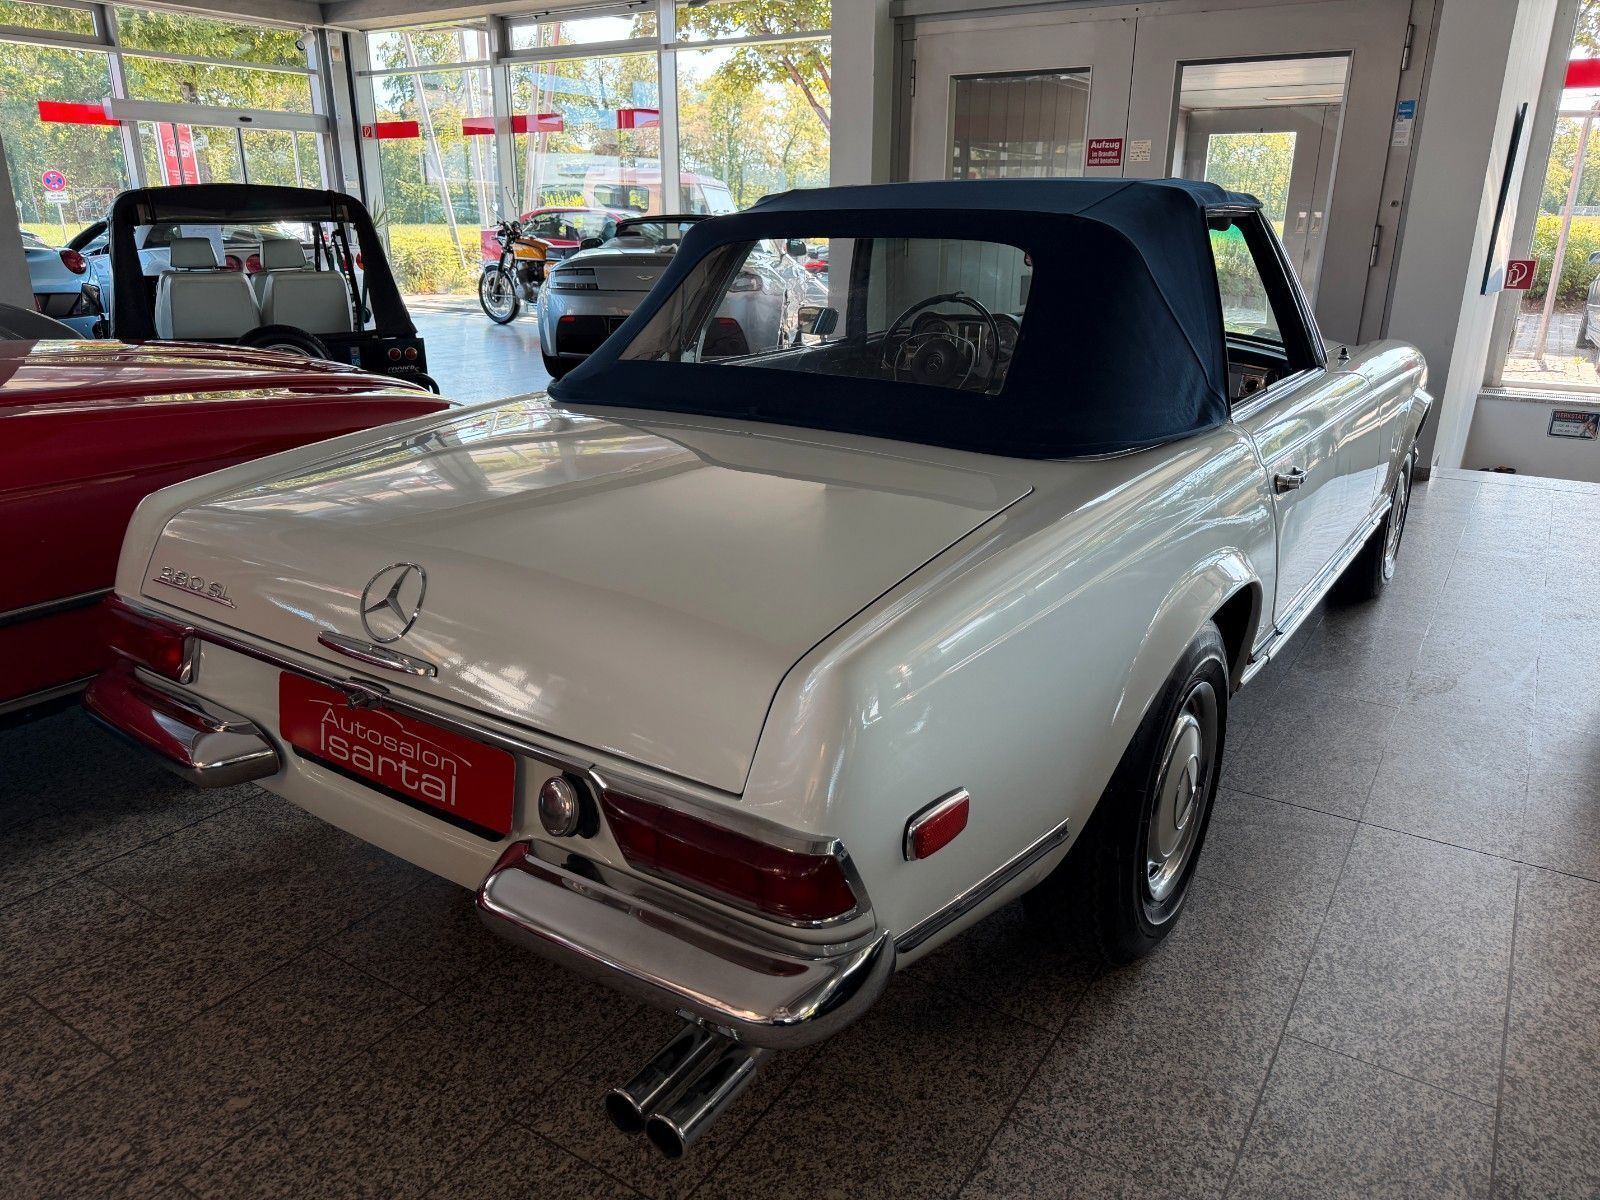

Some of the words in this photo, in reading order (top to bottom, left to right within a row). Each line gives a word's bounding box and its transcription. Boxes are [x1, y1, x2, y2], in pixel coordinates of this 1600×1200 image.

[1091, 141, 1120, 149] Aufzug
[1098, 150, 1118, 158] Brandfall
[206, 581, 233, 602] SL
[321, 707, 457, 775] Autosalon
[320, 722, 457, 806] Isartal
